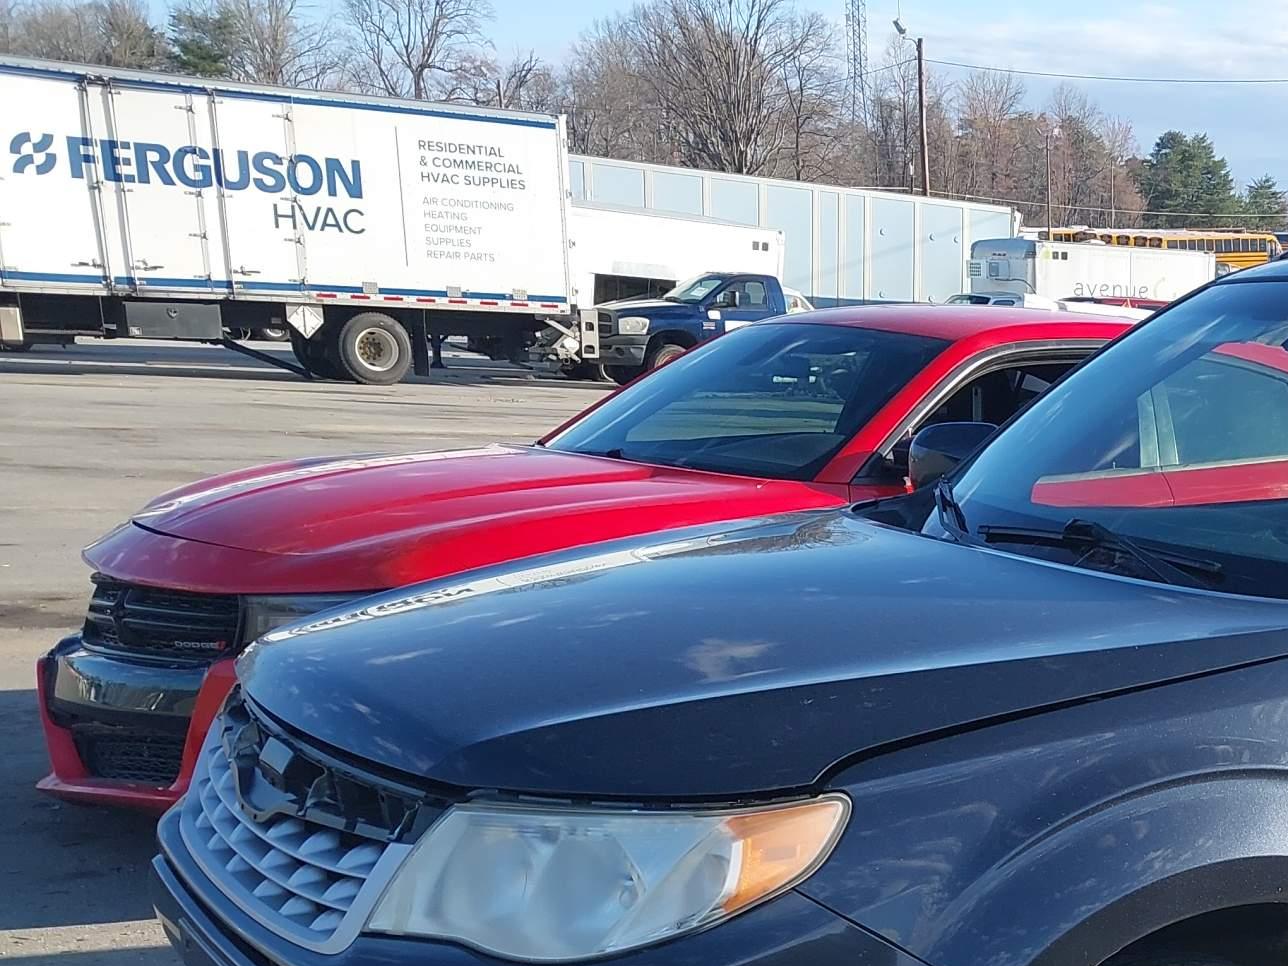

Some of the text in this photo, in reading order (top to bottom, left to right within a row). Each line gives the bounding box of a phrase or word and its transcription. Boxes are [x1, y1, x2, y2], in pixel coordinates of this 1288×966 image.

[418, 140, 504, 158] RESIDENTIAL
[66, 136, 364, 199] FERGUSON
[419, 155, 523, 175] & COMMERCIAL
[421, 171, 526, 190] HVAC SUPPLIES
[423, 196, 514, 212] AIR CONDITIONING
[272, 203, 366, 235] HVAC
[424, 209, 468, 221] HEATING
[424, 223, 482, 235] EQUIPMENT
[425, 236, 472, 248] SUPPLIES
[426, 250, 495, 262] REPAIR PARTS
[1073, 282, 1149, 298] avenue
[175, 641, 219, 649] DODGE
